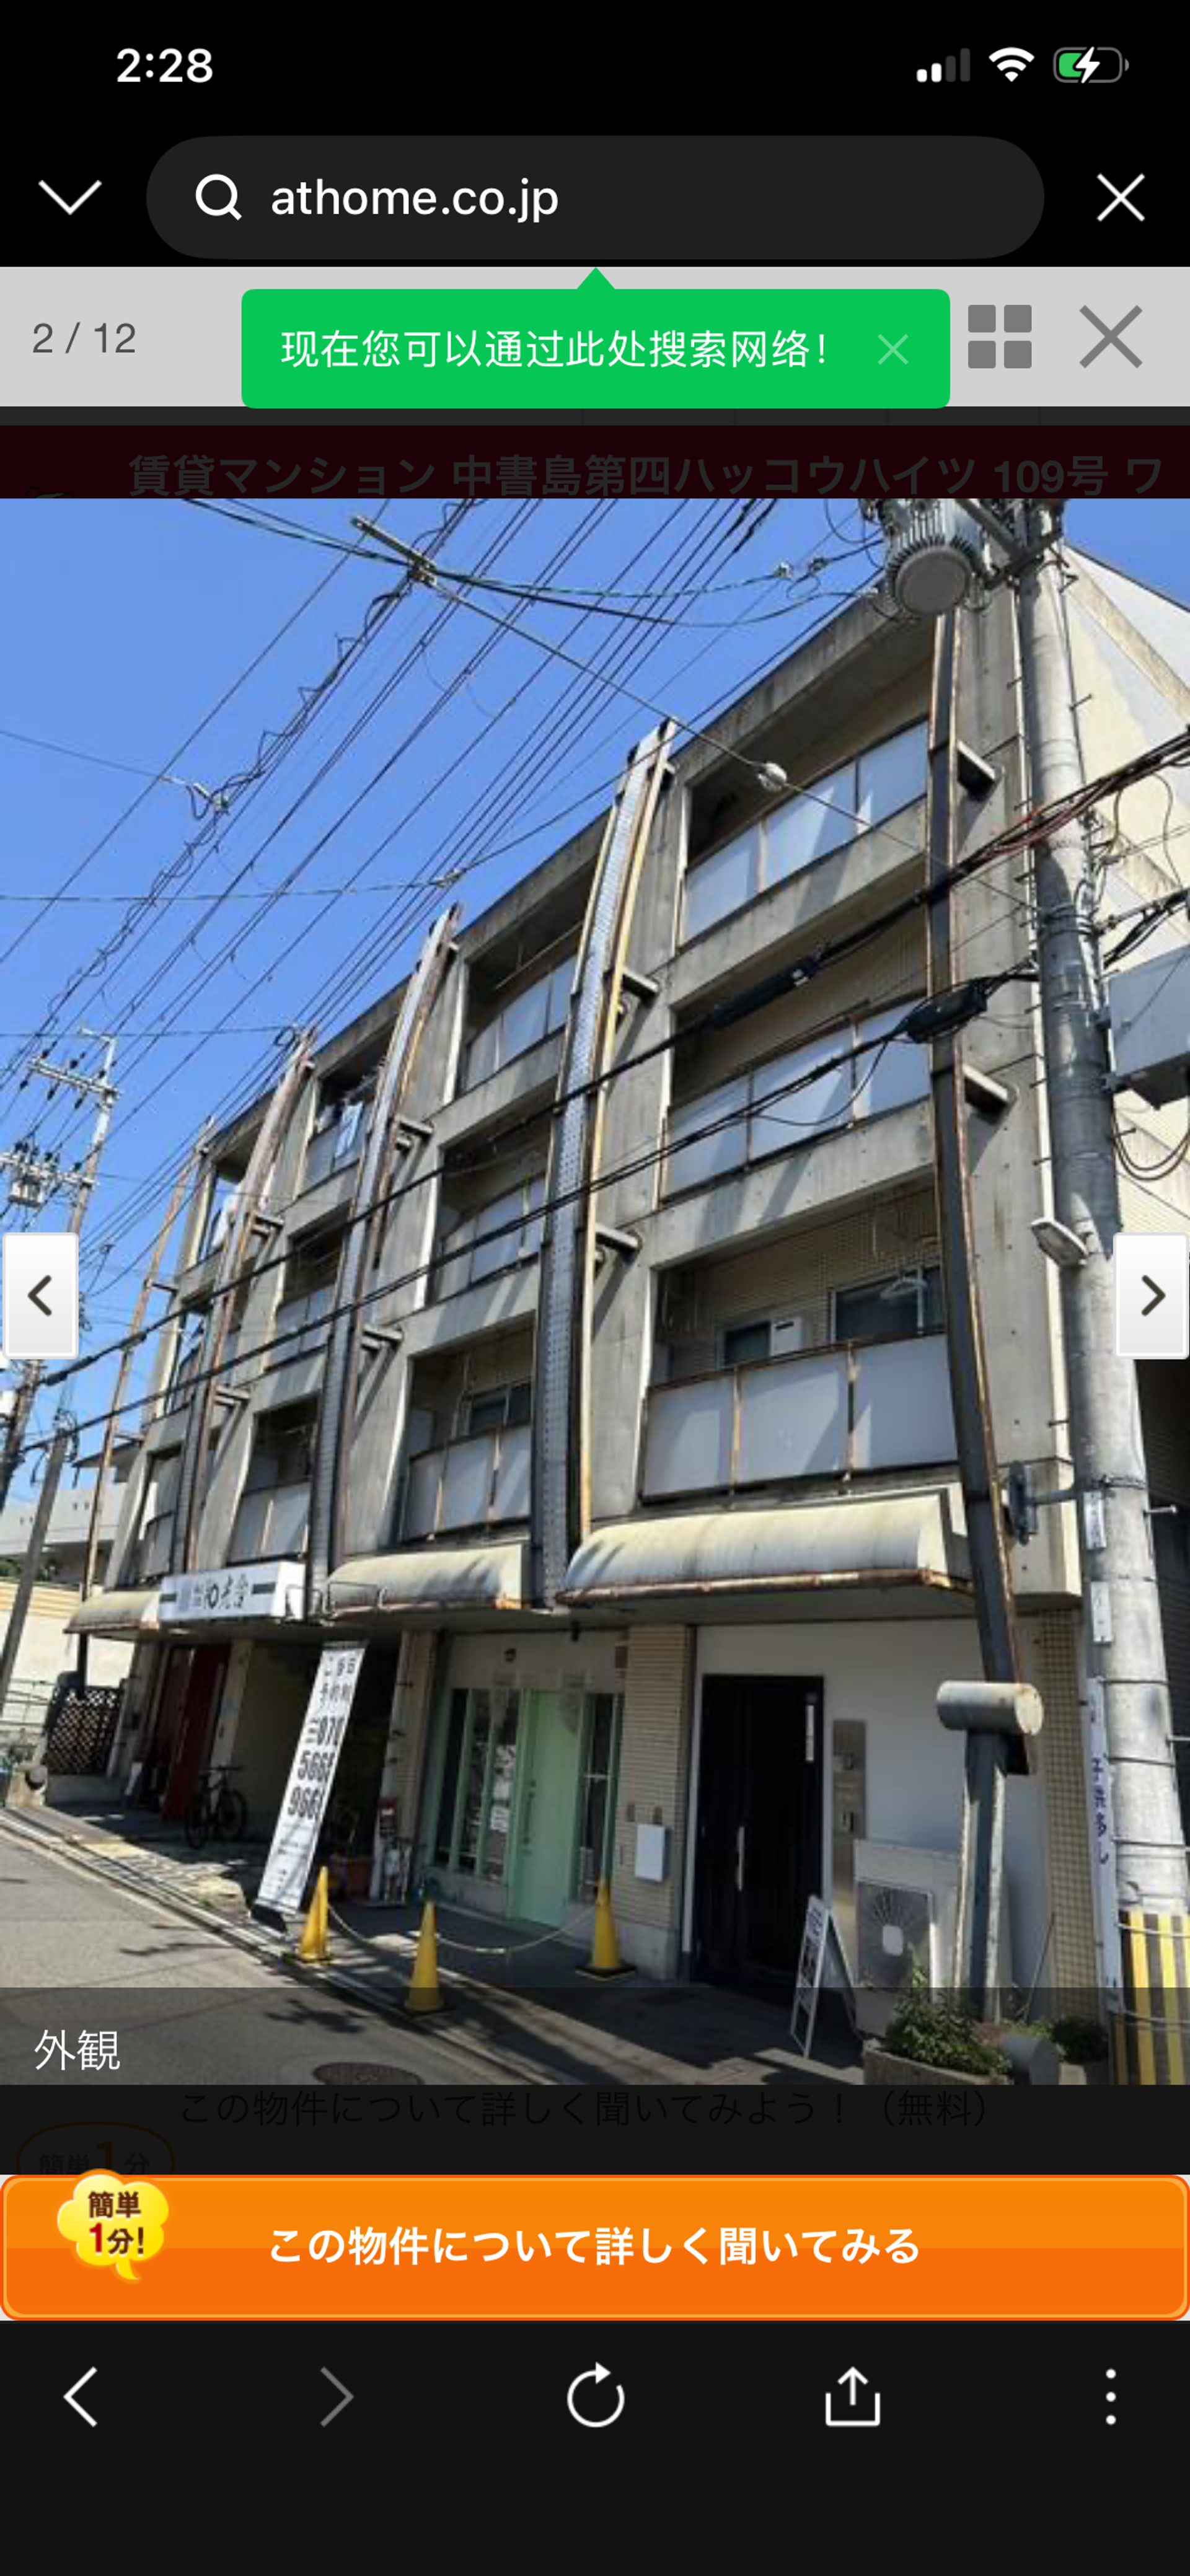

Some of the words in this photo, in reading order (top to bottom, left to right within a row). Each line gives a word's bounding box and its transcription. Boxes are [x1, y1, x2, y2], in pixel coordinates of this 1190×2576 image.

[117, 48, 213, 83] 2:28
[271, 177, 558, 223] athome.co.jp
[32, 324, 53, 354] 2
[94, 324, 136, 354] 12
[281, 330, 825, 368] 现在您可以通过此处搜索网络！
[128, 454, 435, 497] 賃貸マンション
[453, 454, 975, 497] 中書島第四ハッコウハイツ
[994, 454, 1109, 497] 109号
[1127, 457, 1161, 496] ワ
[88, 2191, 141, 2218] 簡単
[89, 2223, 144, 2254] 1分!
[270, 2225, 919, 2266] この物件について詳しく聞いてみる
